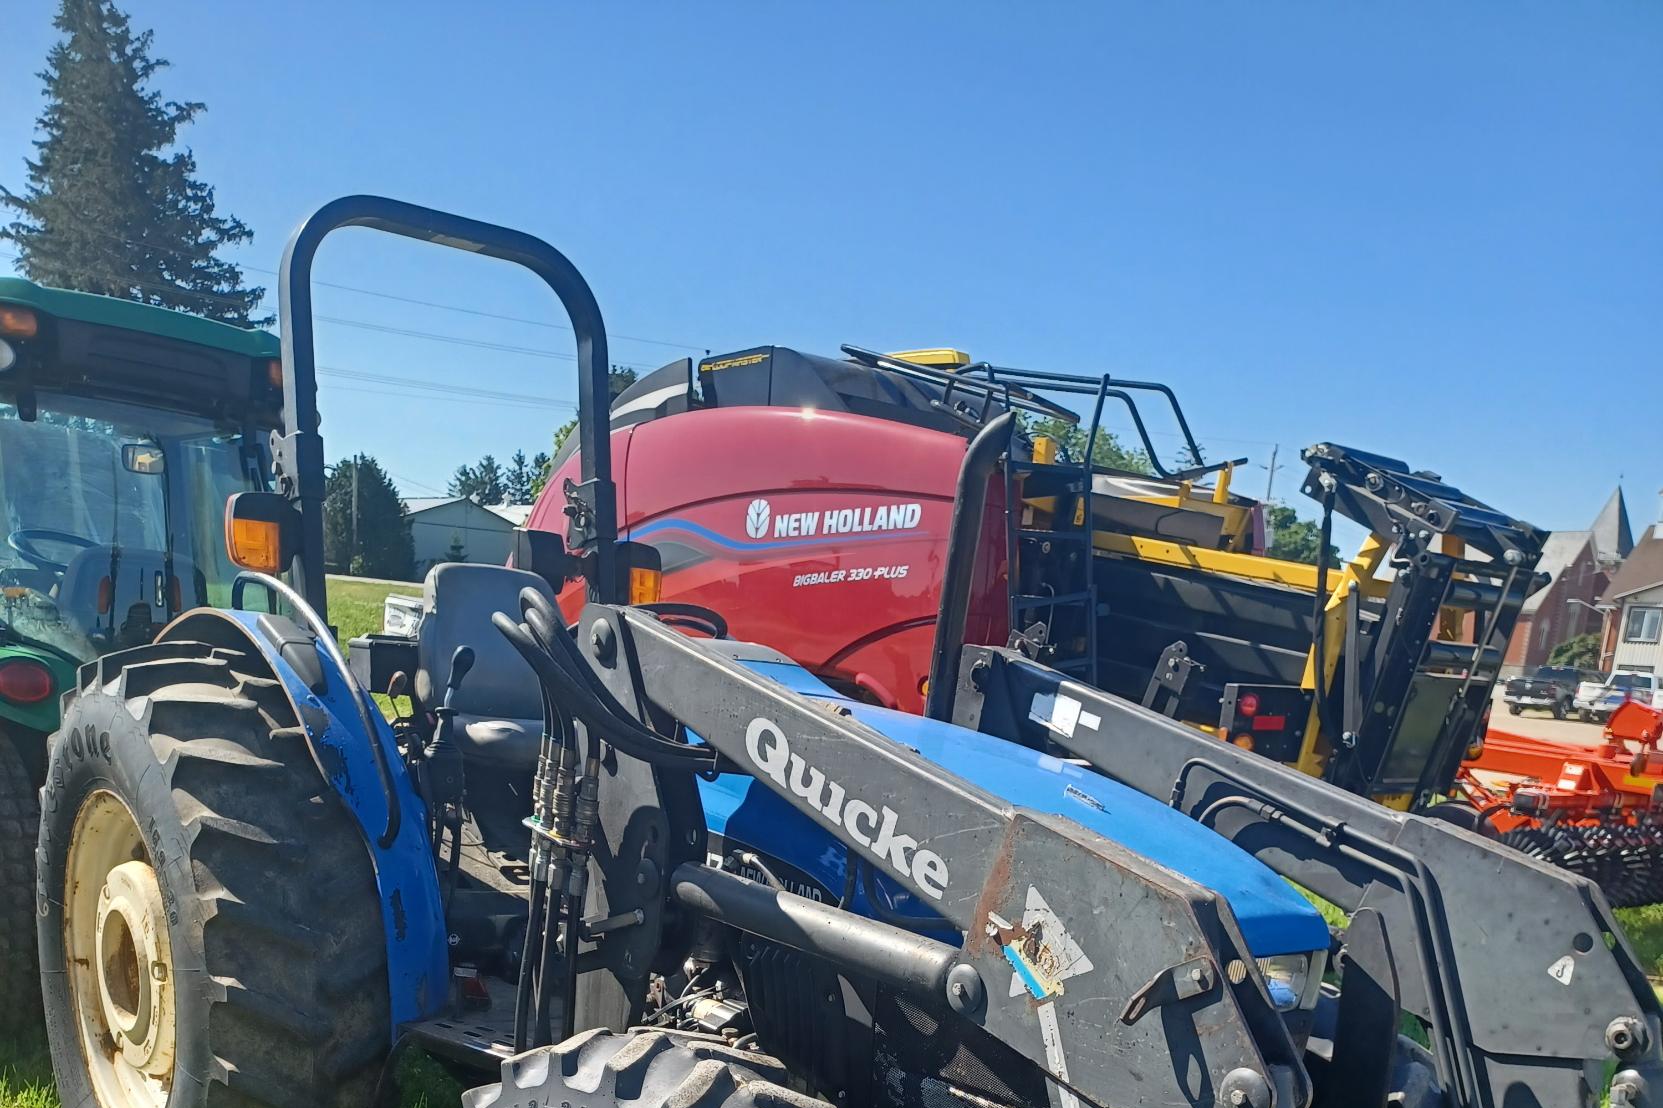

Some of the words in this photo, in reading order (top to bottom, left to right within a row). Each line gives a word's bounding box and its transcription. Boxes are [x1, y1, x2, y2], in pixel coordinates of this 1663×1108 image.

[774, 511, 820, 538] NEW
[822, 503, 922, 534] HOLLAND
[793, 570, 845, 588] BIGBALER
[847, 568, 873, 581] 330
[873, 565, 909, 579] PLUS
[745, 716, 949, 900] Quicke
